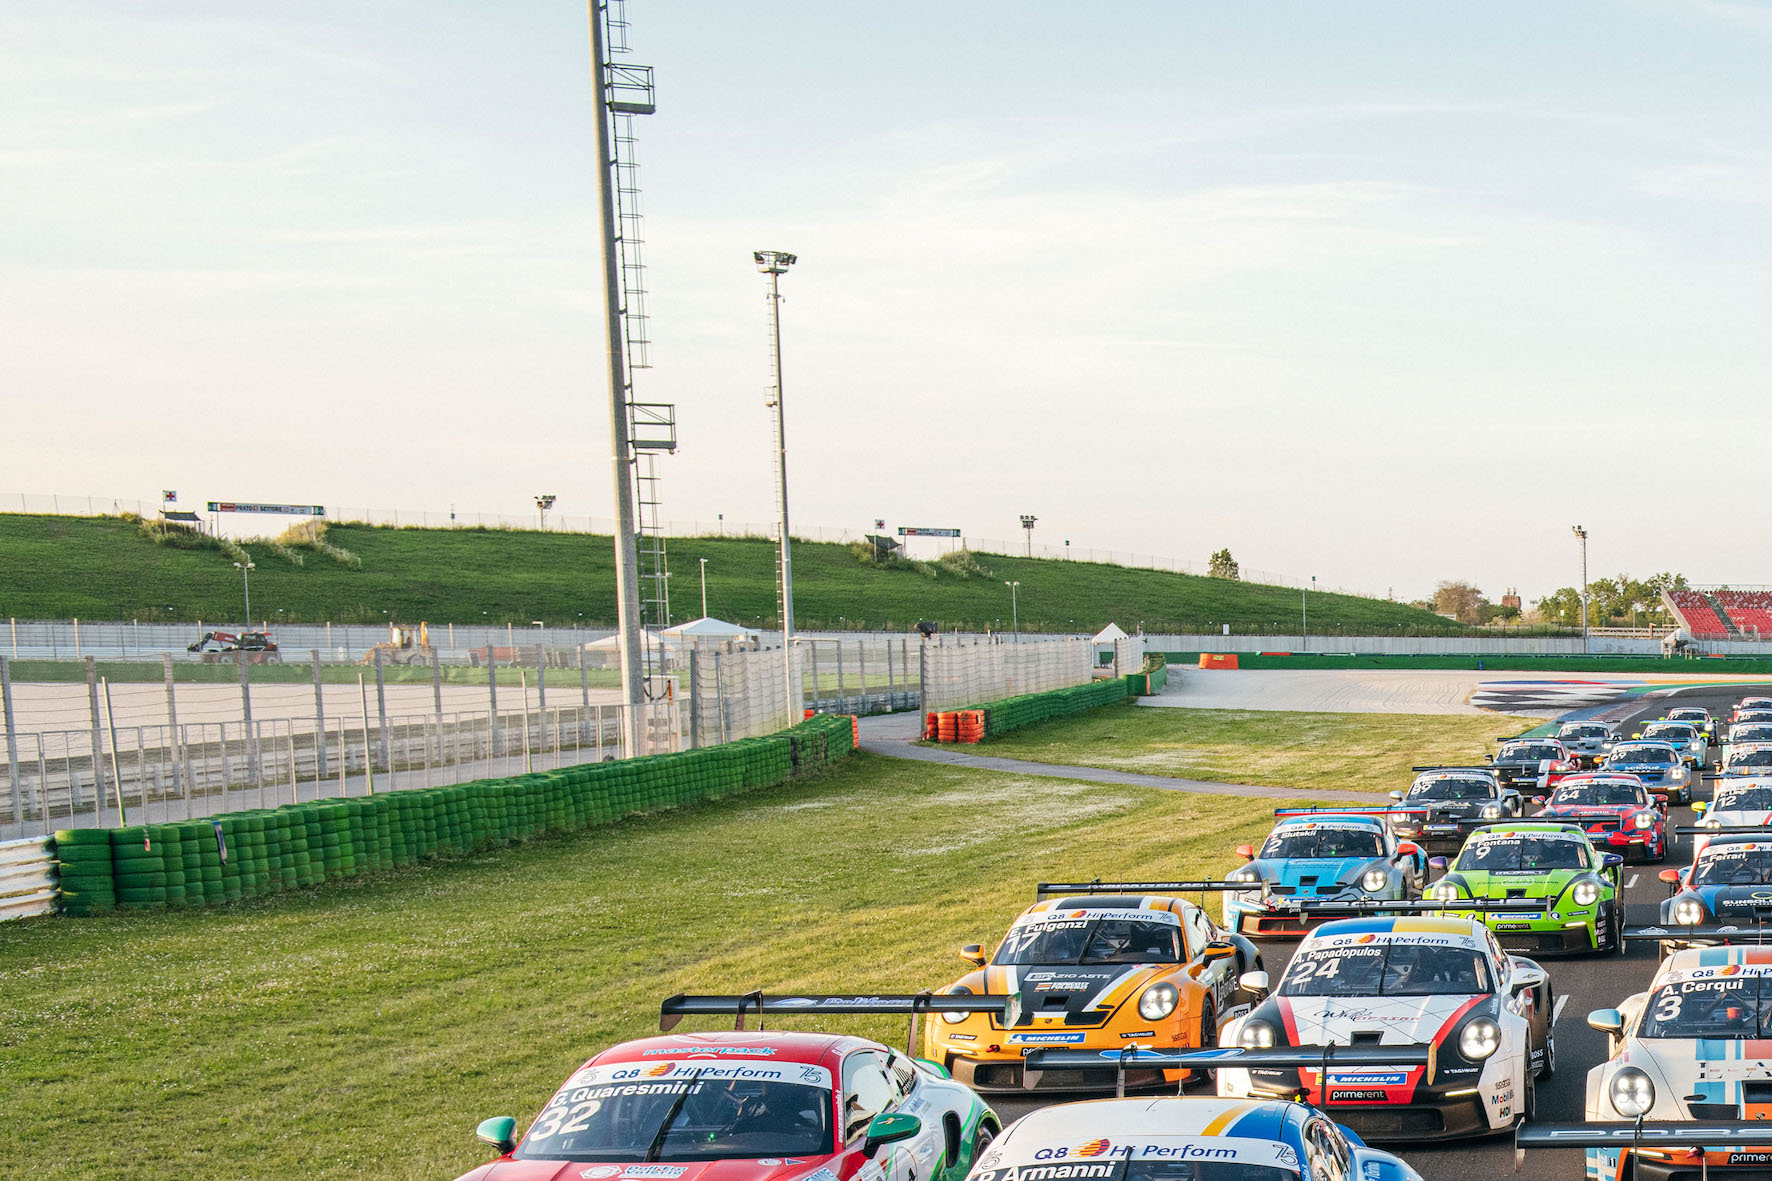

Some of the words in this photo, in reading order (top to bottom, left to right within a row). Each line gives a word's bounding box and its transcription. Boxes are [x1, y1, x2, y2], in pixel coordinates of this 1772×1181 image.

[1558, 790, 1580, 802] 64
[1266, 839, 1283, 854] 2
[1477, 840, 1520, 848] Fontana
[1475, 846, 1492, 860] 9
[1710, 852, 1746, 862] Ferrari
[1698, 862, 1714, 879] 7
[1104, 912, 1153, 920] Perform
[1026, 920, 1088, 932] Fulgenzi
[1006, 931, 1042, 955] 17
[1332, 937, 1352, 946] Q8
[1394, 936, 1449, 946] Perform
[1306, 946, 1382, 962] Papadopulos
[1292, 958, 1340, 986] 24
[1692, 969, 1714, 978] Q8
[1660, 984, 1679, 998] A.
[1681, 979, 1744, 994] Cerqui
[1654, 996, 1683, 1022] 3
[642, 1046, 777, 1057] masterpack
[612, 1068, 640, 1080] Q8
[674, 1067, 694, 1078] Hi
[696, 1066, 782, 1081] Perform
[1339, 1074, 1400, 1084] MICHELIN
[552, 1092, 569, 1106] G.
[570, 1080, 704, 1104] Quaresmini
[1332, 1090, 1385, 1100] primerent
[528, 1100, 602, 1142] 32
[1034, 1147, 1069, 1161] Q8
[1142, 1144, 1237, 1160] Perform
